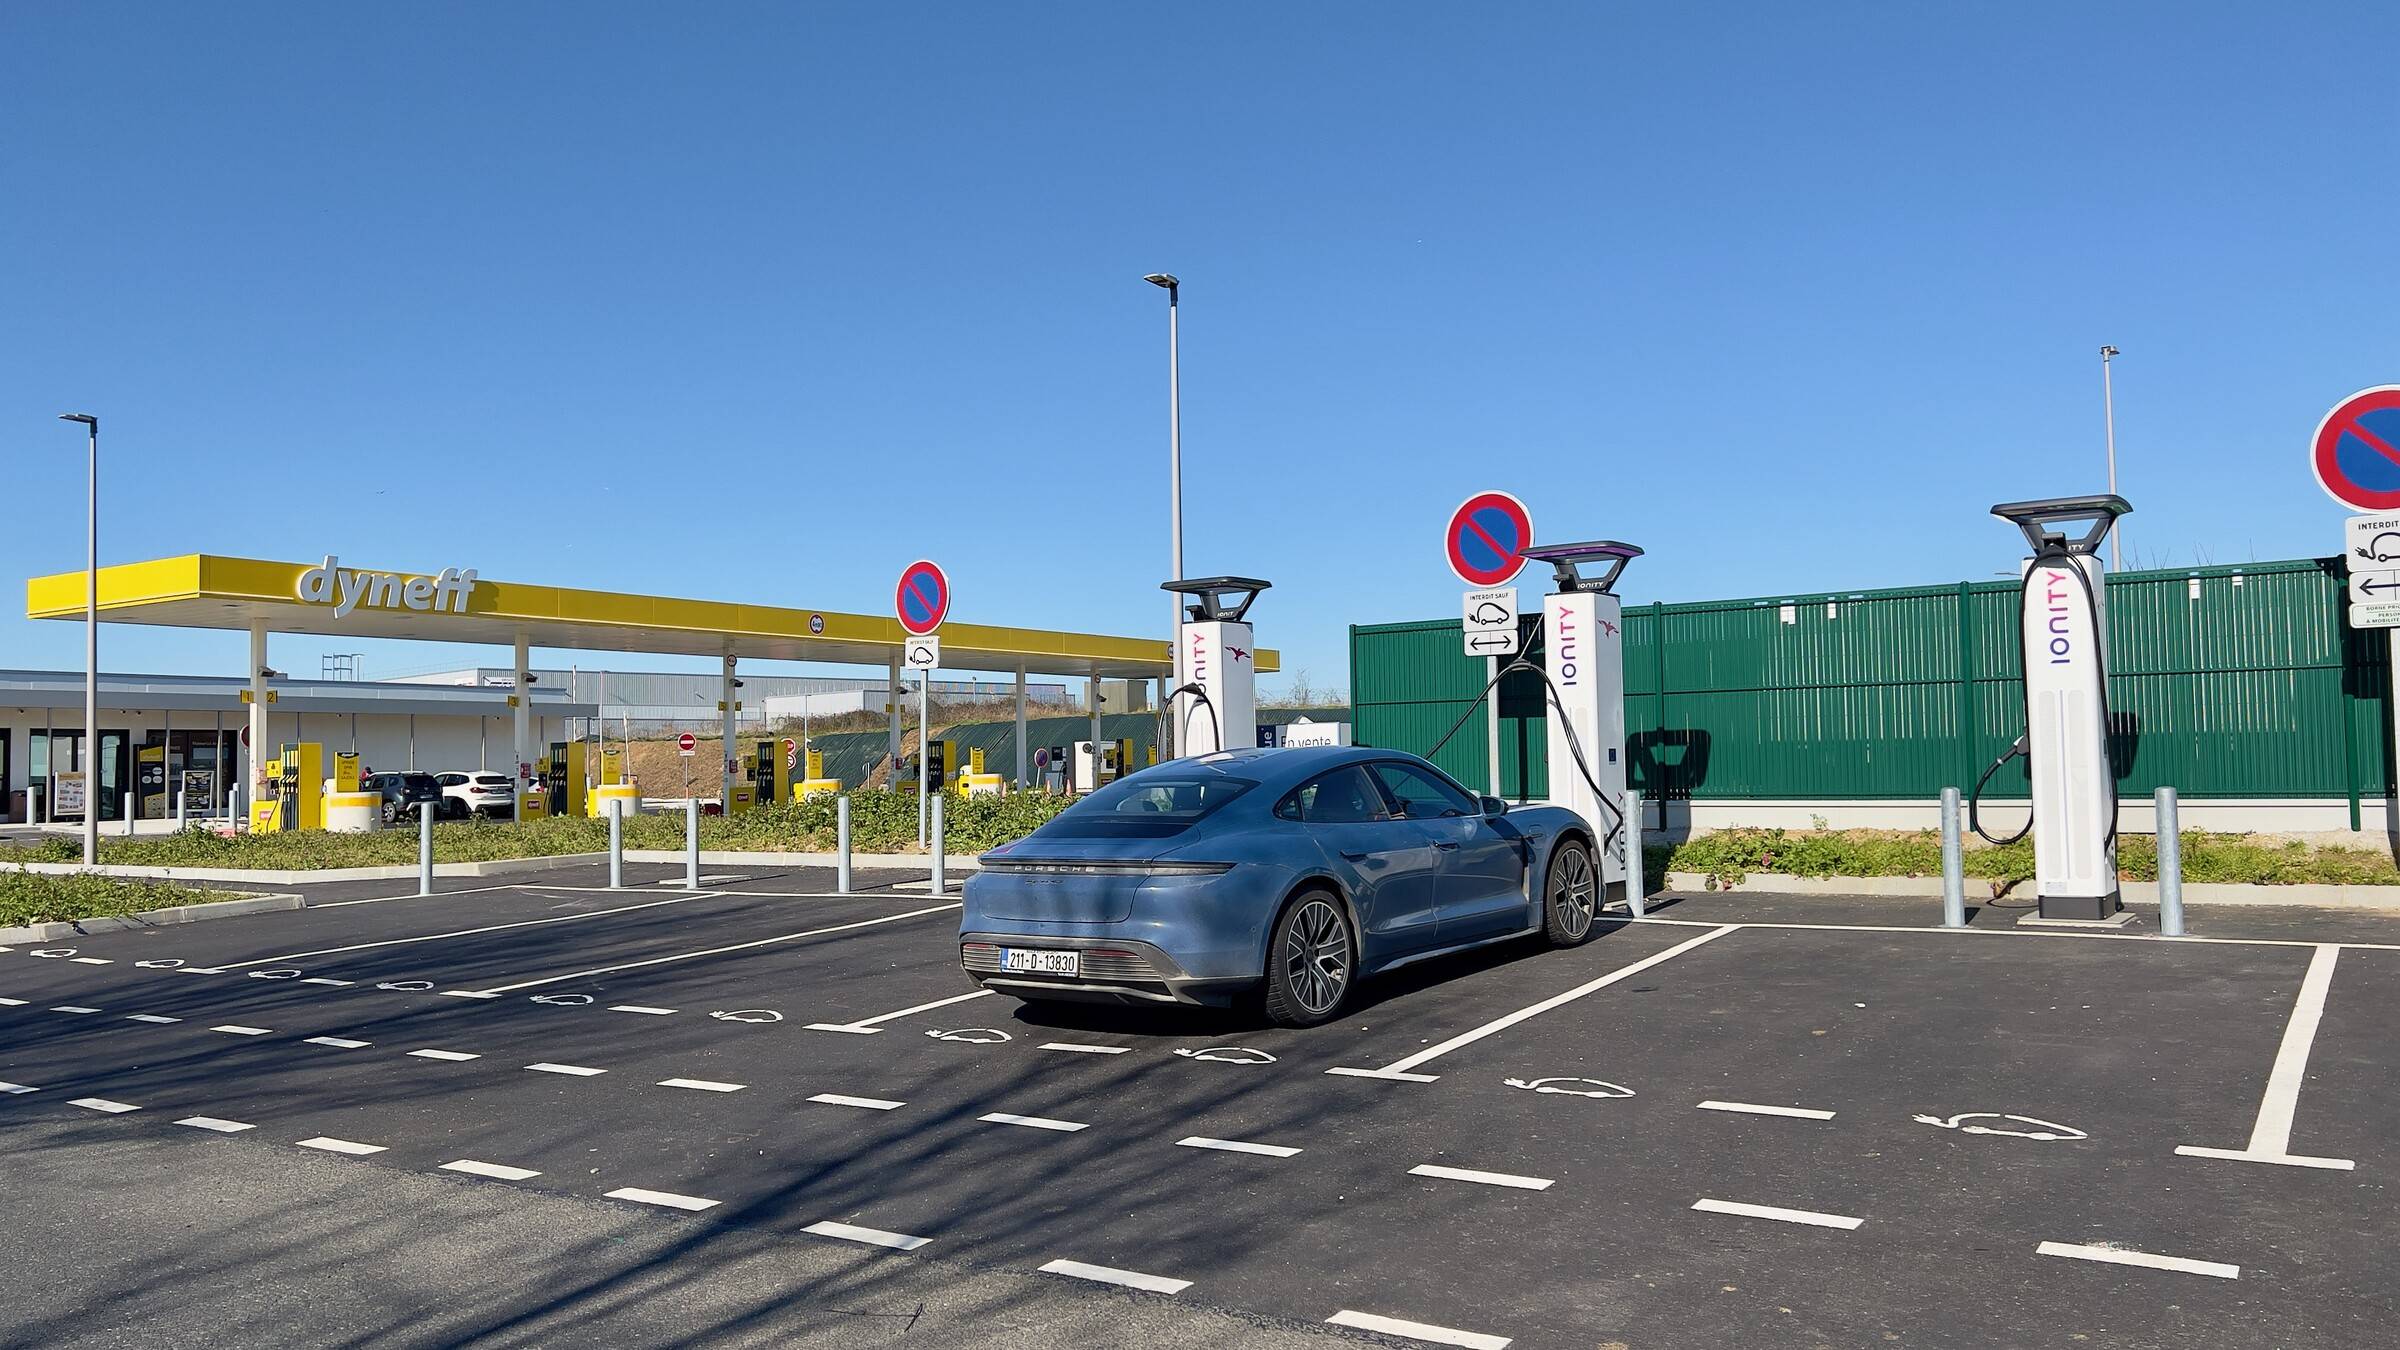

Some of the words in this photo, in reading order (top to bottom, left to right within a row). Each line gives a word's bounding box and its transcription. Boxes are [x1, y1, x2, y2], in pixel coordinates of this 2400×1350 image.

[2358, 521, 2399, 530] INTERDIT
[298, 555, 478, 619] dyneff
[2047, 571, 2070, 664] IONITY
[1560, 606, 1577, 686] IONITY
[267, 692, 273, 703] 2
[1298, 736, 1331, 747] vente
[1010, 952, 1075, 972] 211-D-13830
